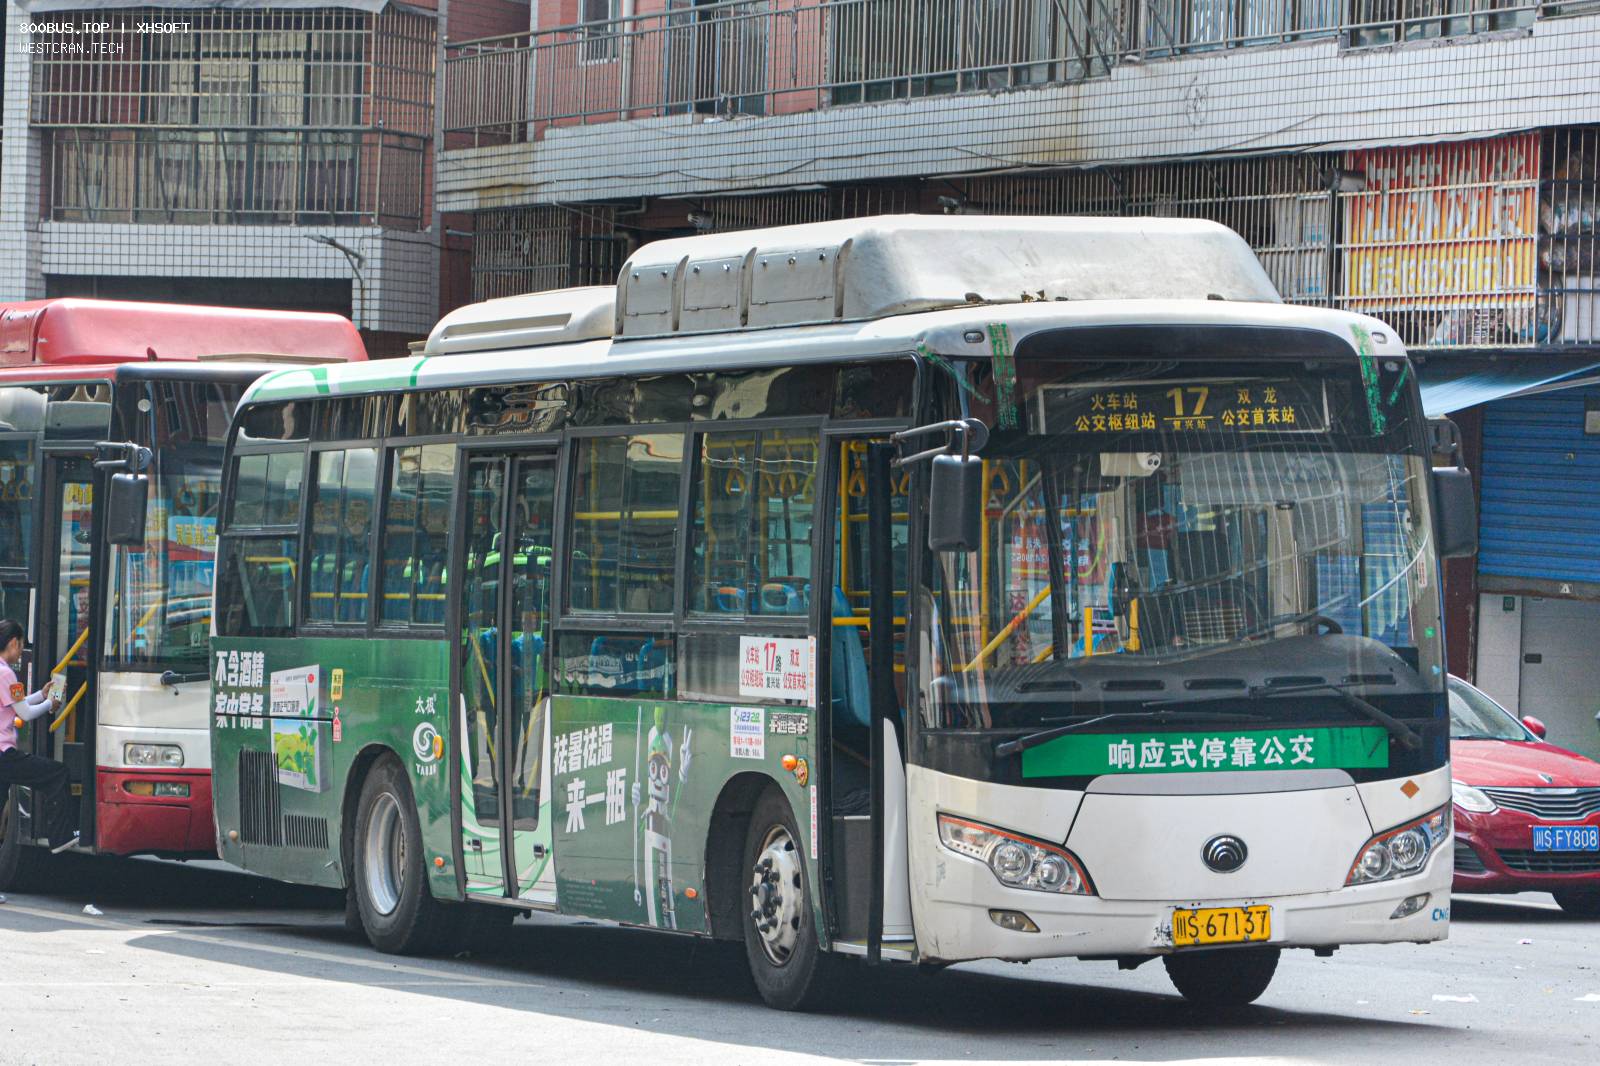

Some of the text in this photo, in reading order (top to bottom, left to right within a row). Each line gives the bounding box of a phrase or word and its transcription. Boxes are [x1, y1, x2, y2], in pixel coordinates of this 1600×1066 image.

[1091, 391, 1138, 411] 火车站
[1166, 386, 1209, 416] 17
[1237, 386, 1278, 405] 双龙
[1075, 411, 1157, 432] 公交枢纽站
[1221, 405, 1295, 426] 公交首末站
[215, 650, 265, 688] 不含酒精
[414, 695, 436, 715] 太极
[1108, 735, 1315, 769] 响应式停靠公交
[565, 767, 627, 834] 来一瓶
